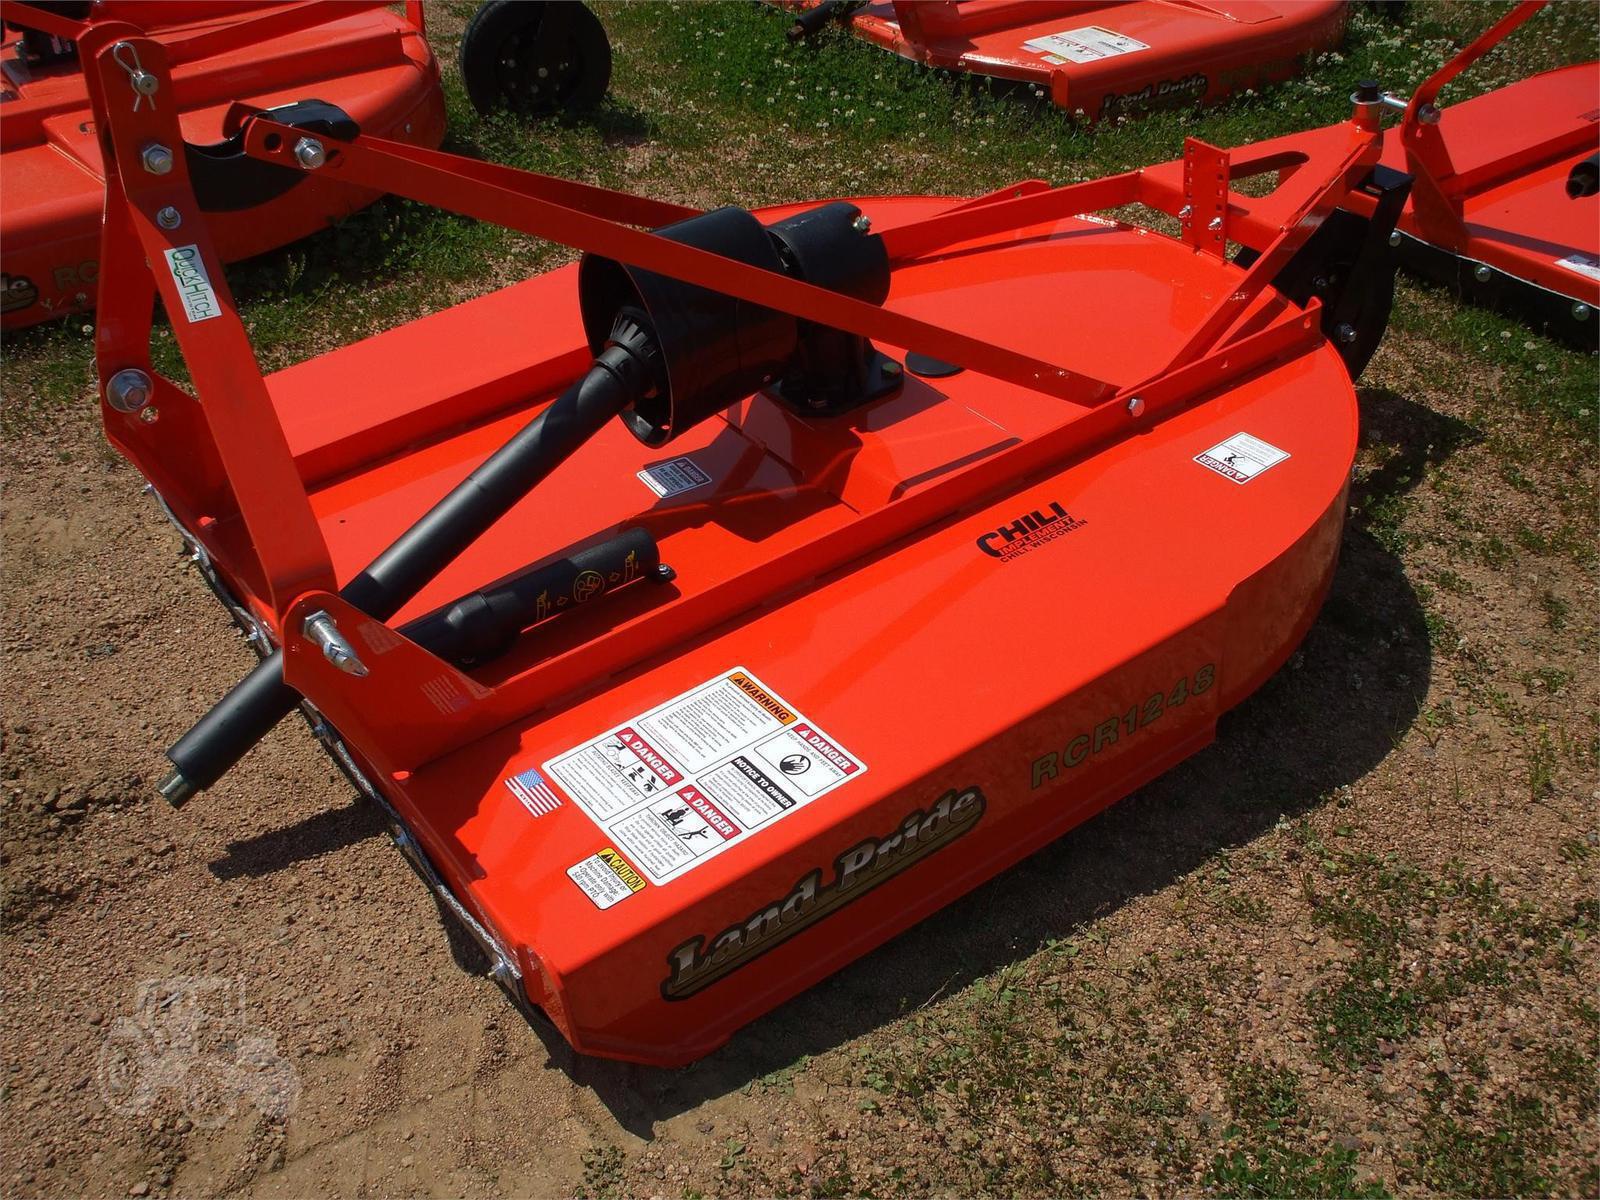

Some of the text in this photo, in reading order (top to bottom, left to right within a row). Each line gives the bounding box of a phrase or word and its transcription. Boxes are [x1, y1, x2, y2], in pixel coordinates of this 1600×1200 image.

[1199, 455, 1238, 476] DANGER
[976, 501, 1068, 558] CHILI
[999, 516, 1076, 556] IMPLEMENT
[1031, 519, 1088, 548] WISCONSIN
[743, 681, 790, 721] WARNING
[1031, 663, 1216, 790] RCR1248
[630, 740, 676, 780] DANGER
[808, 735, 852, 769] DANGER
[733, 757, 761, 780] NOTICE
[755, 777, 769, 788] TO
[765, 785, 793, 808] OWNER
[692, 798, 735, 836] DANGER
[608, 858, 645, 889] CAUTION
[667, 867, 821, 987] Land
[837, 788, 981, 893] Pride
